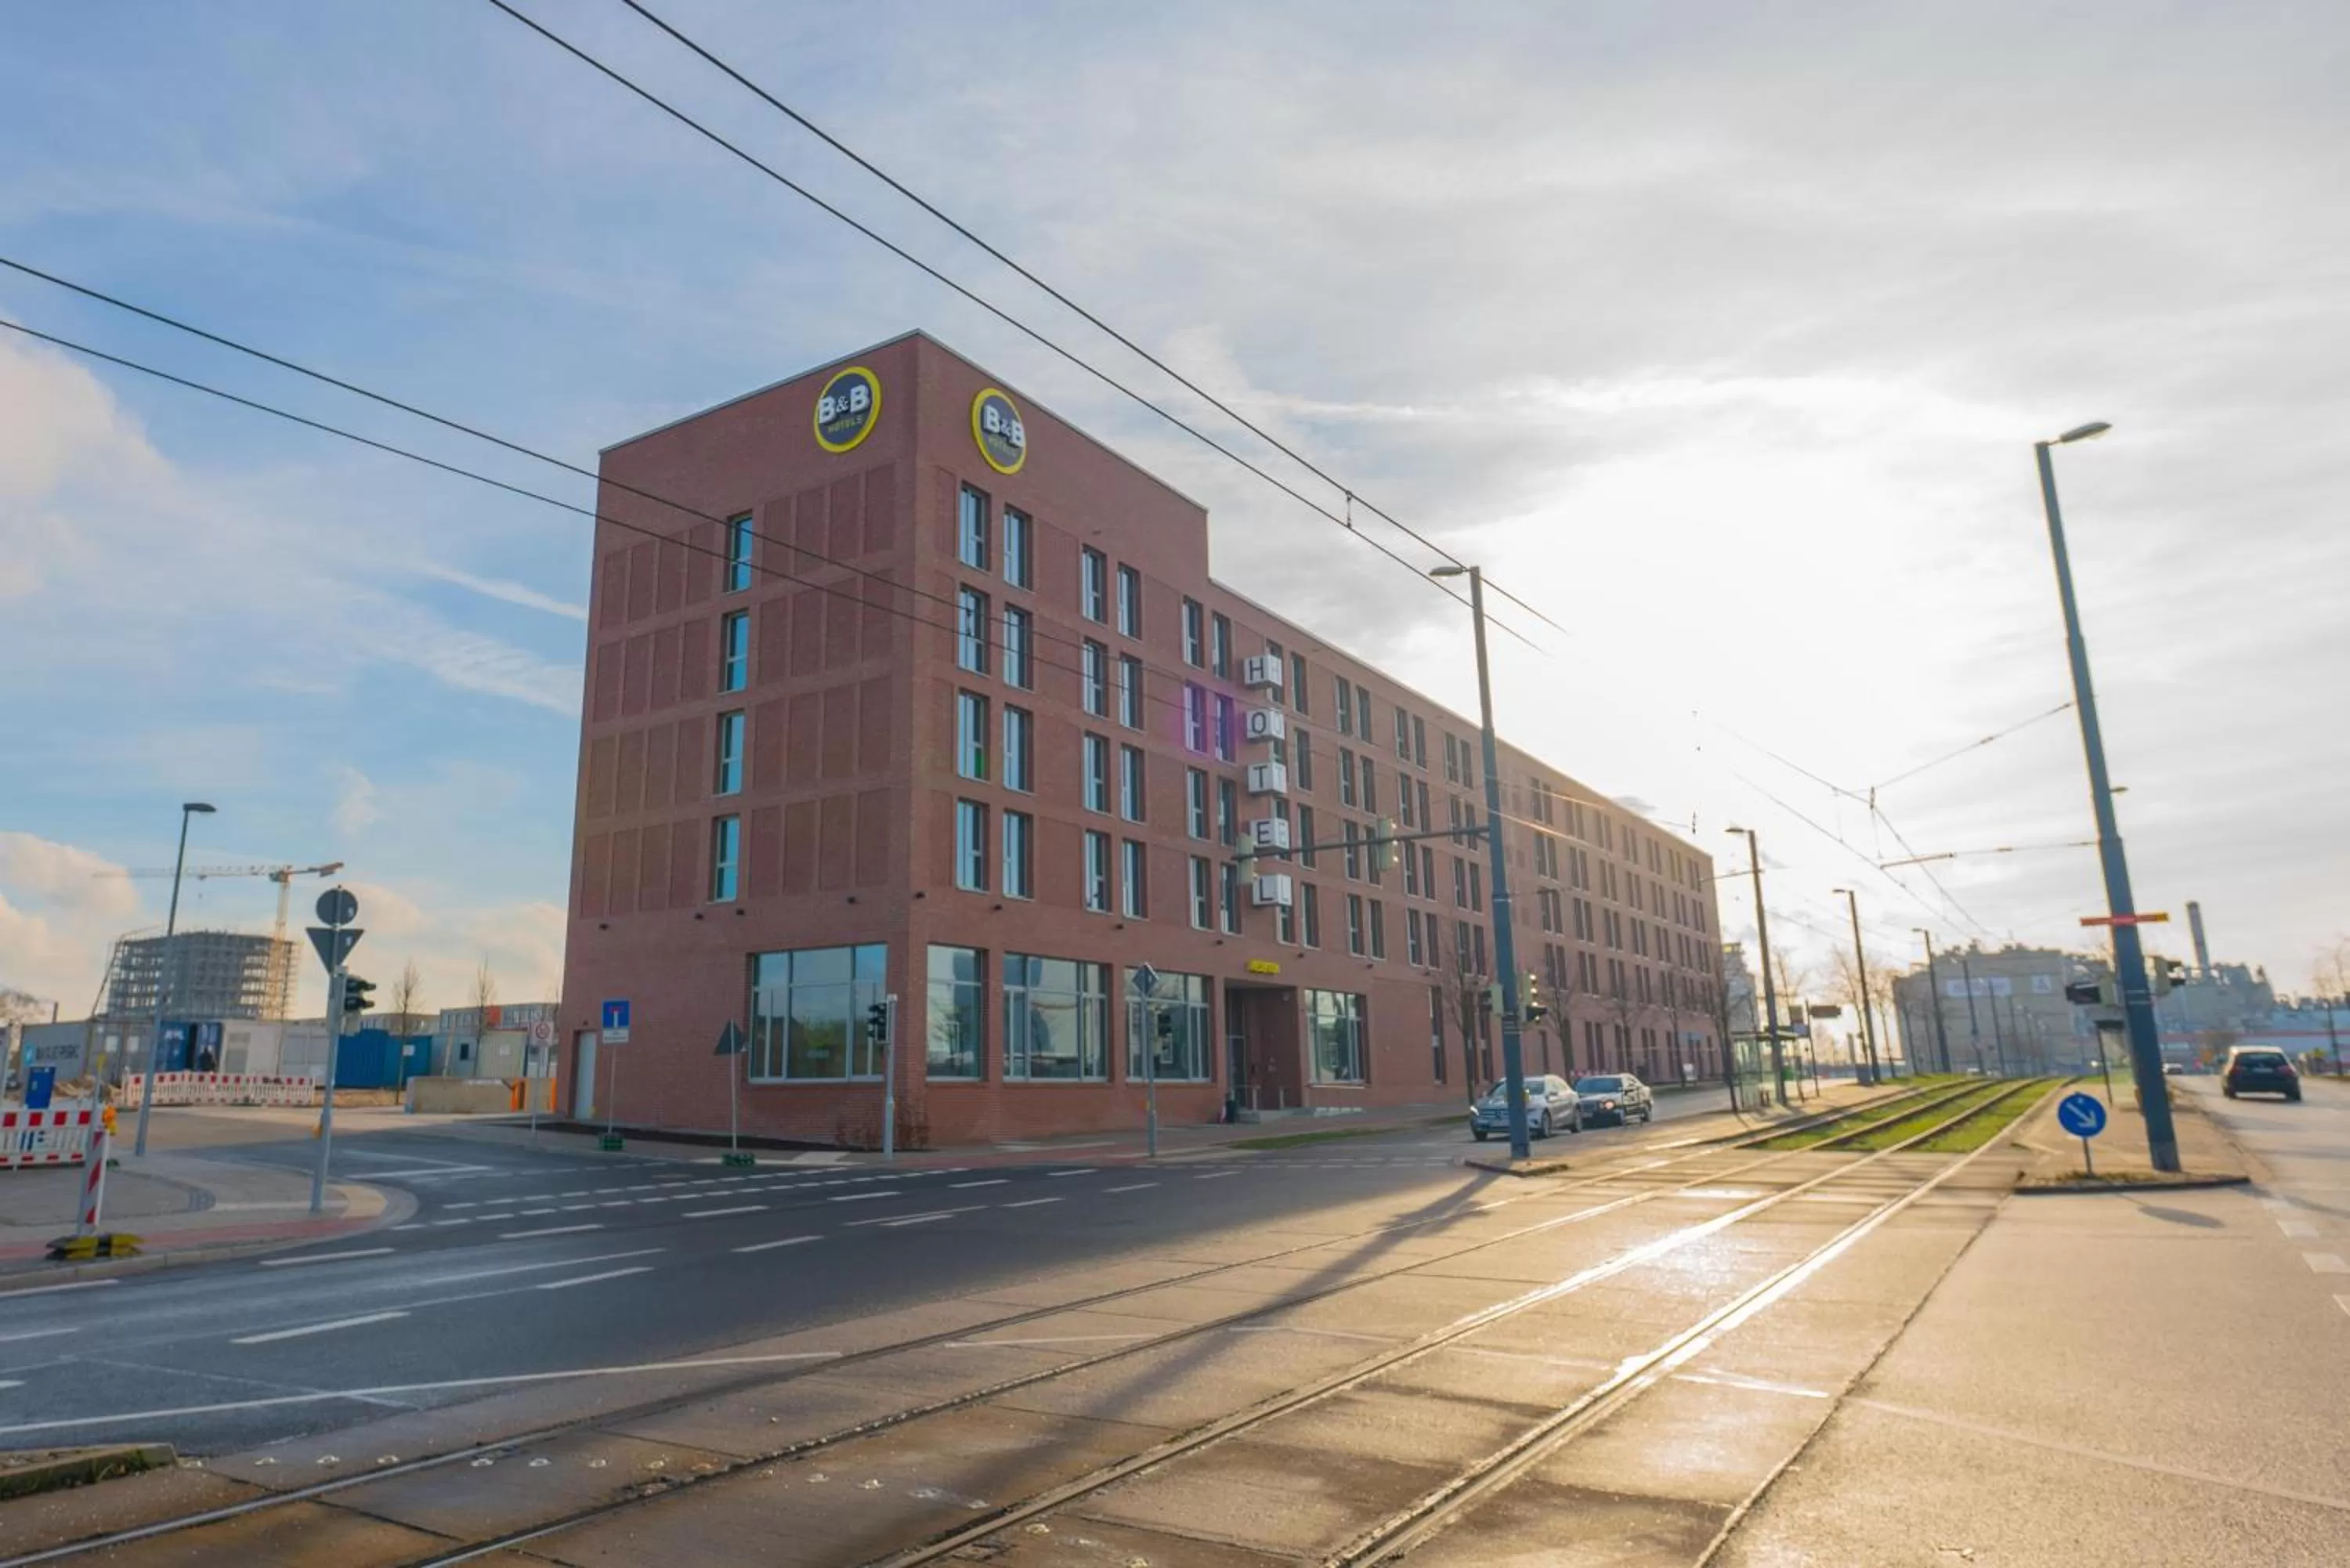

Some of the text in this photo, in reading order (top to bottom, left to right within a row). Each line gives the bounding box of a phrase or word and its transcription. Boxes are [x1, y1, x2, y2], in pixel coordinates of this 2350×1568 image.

[818, 385, 870, 424] B&B
[983, 404, 1025, 448] B&B
[1249, 656, 1274, 901] HOTEL
